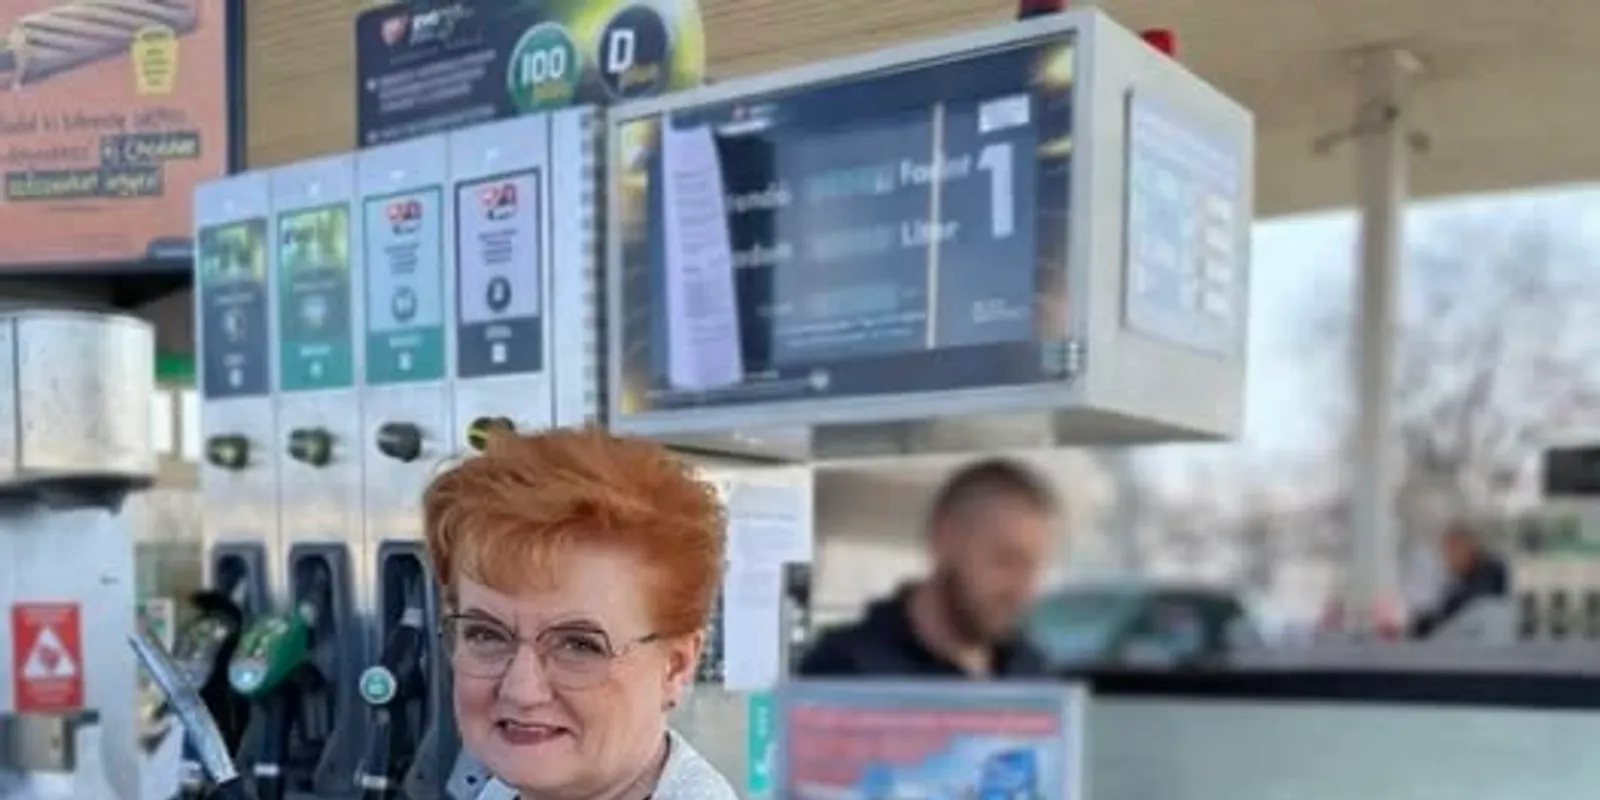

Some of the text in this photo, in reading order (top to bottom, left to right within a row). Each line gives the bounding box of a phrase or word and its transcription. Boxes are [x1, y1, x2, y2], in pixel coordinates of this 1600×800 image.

[522, 47, 566, 84] 100
[607, 29, 634, 73] D
[977, 143, 1015, 240] 1
